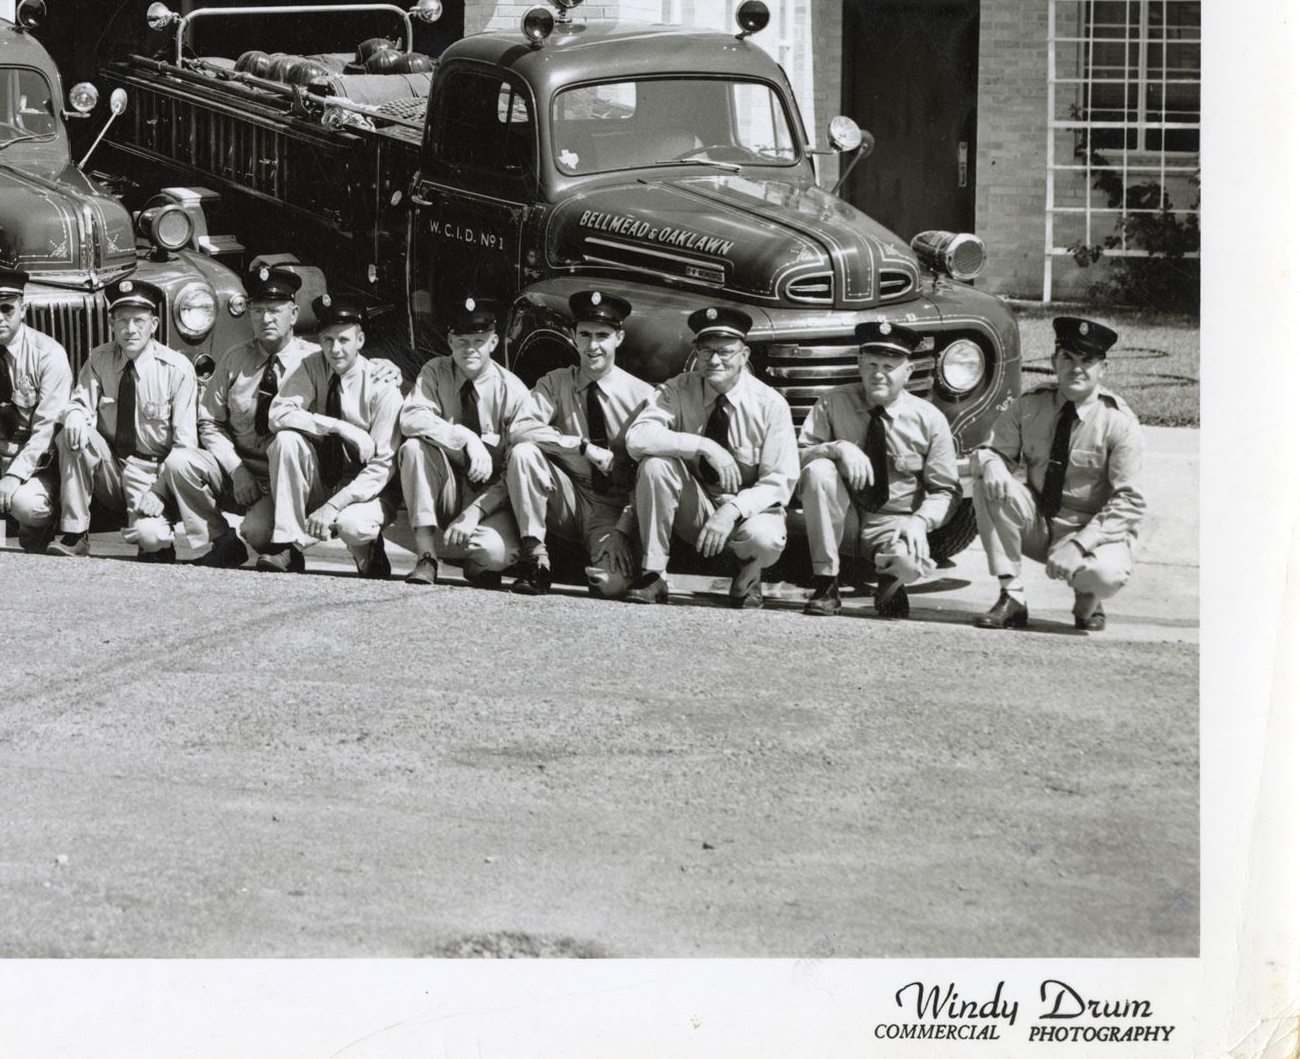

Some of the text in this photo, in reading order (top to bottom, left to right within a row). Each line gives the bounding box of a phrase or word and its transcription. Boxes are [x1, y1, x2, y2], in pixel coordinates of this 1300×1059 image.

[499, 237, 503, 250] 1
[579, 210, 735, 255] BELLMEAD & OAKLAWN
